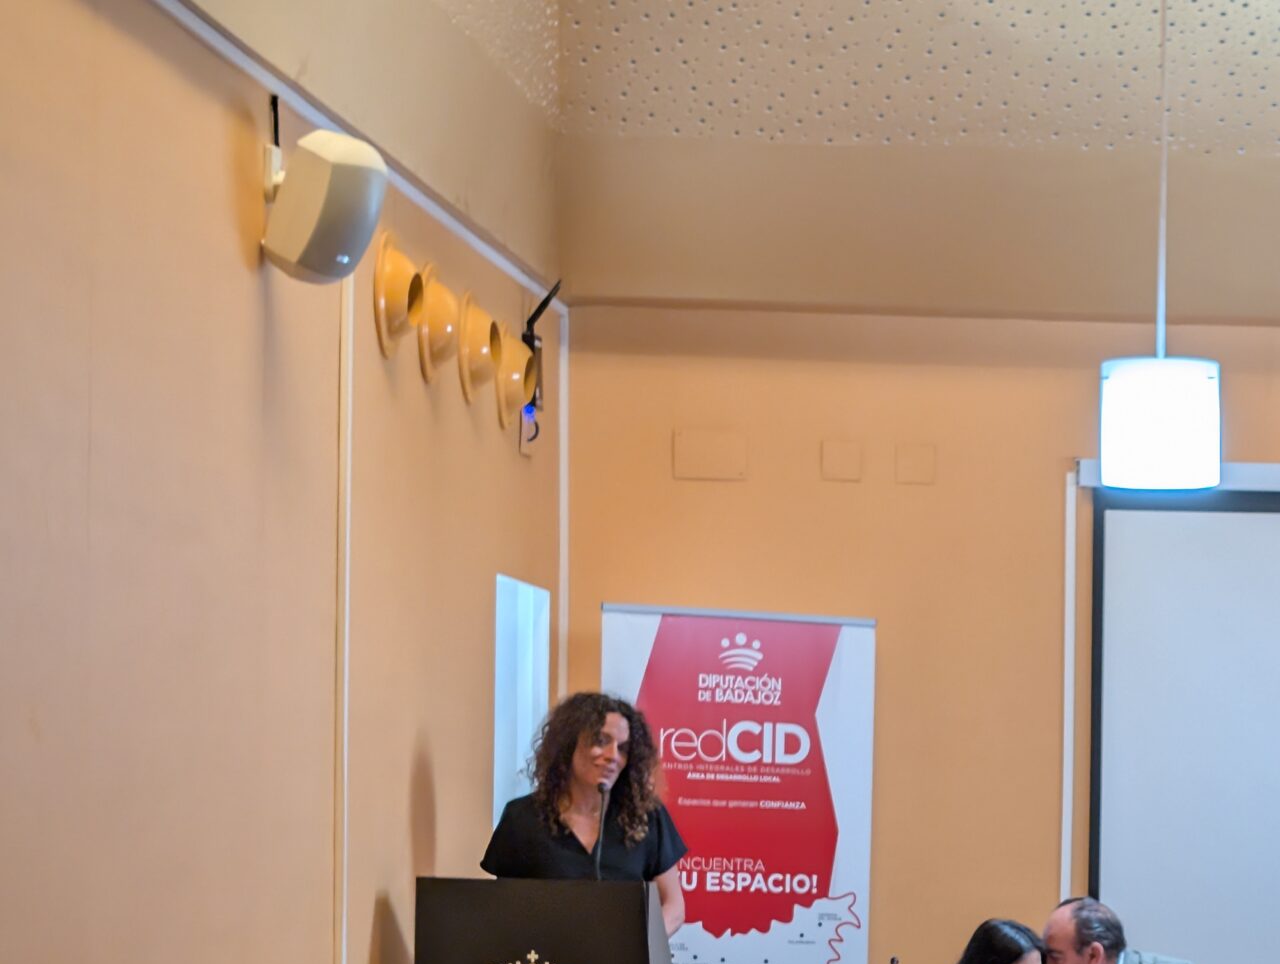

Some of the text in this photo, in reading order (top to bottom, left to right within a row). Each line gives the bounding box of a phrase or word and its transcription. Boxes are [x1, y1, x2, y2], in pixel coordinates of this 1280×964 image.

[698, 673, 782, 690] DIPUTACIÓN
[698, 688, 782, 706] DE BADAJOZ
[659, 718, 811, 765] redCID
[662, 762, 694, 770] ENTROS
[760, 775, 780, 783] LOCAL
[760, 800, 806, 810] CONFIANZA
[678, 856, 766, 872] NCUENTRA
[678, 871, 818, 894] U ESPACIO!
